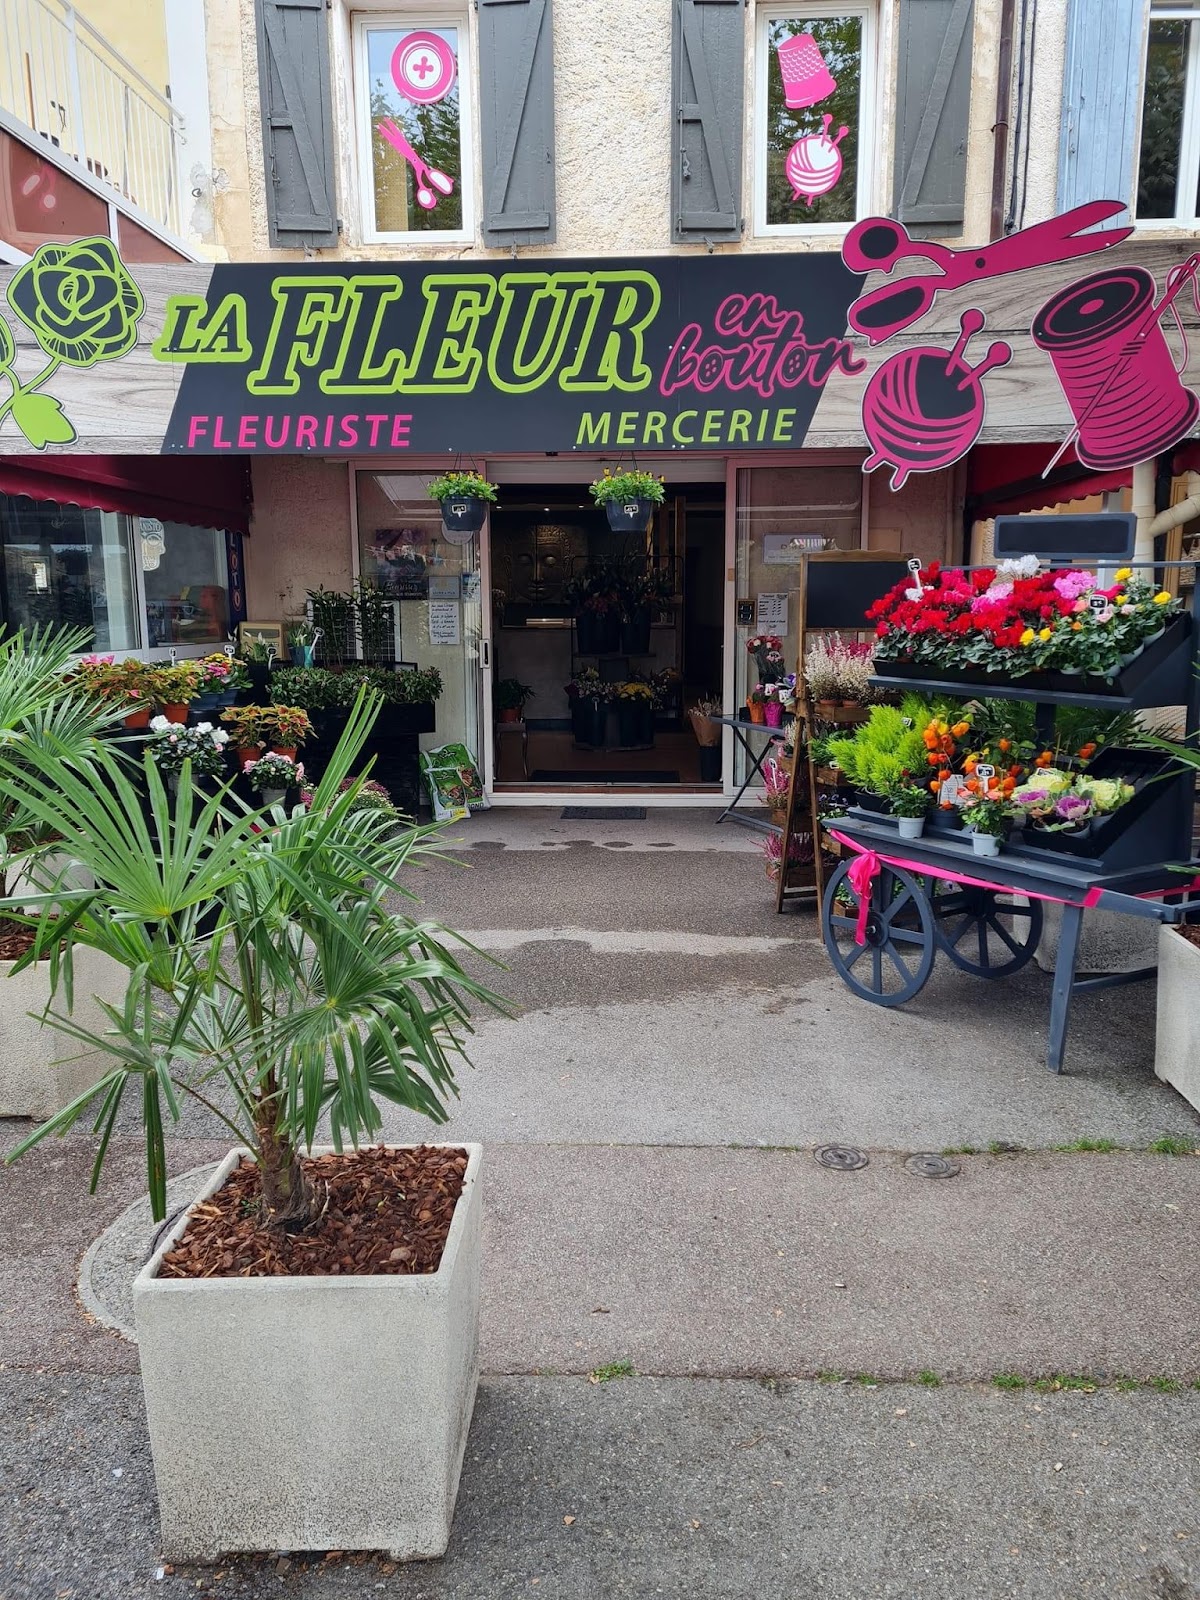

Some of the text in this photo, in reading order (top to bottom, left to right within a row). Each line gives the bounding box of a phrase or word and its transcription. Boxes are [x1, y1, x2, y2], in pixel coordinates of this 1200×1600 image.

[152, 272, 661, 395] LA FLEUR
[716, 293, 788, 338] en
[662, 312, 867, 398] bouton
[187, 414, 414, 448] FLEURISTE
[577, 408, 797, 446] MERCERIE
